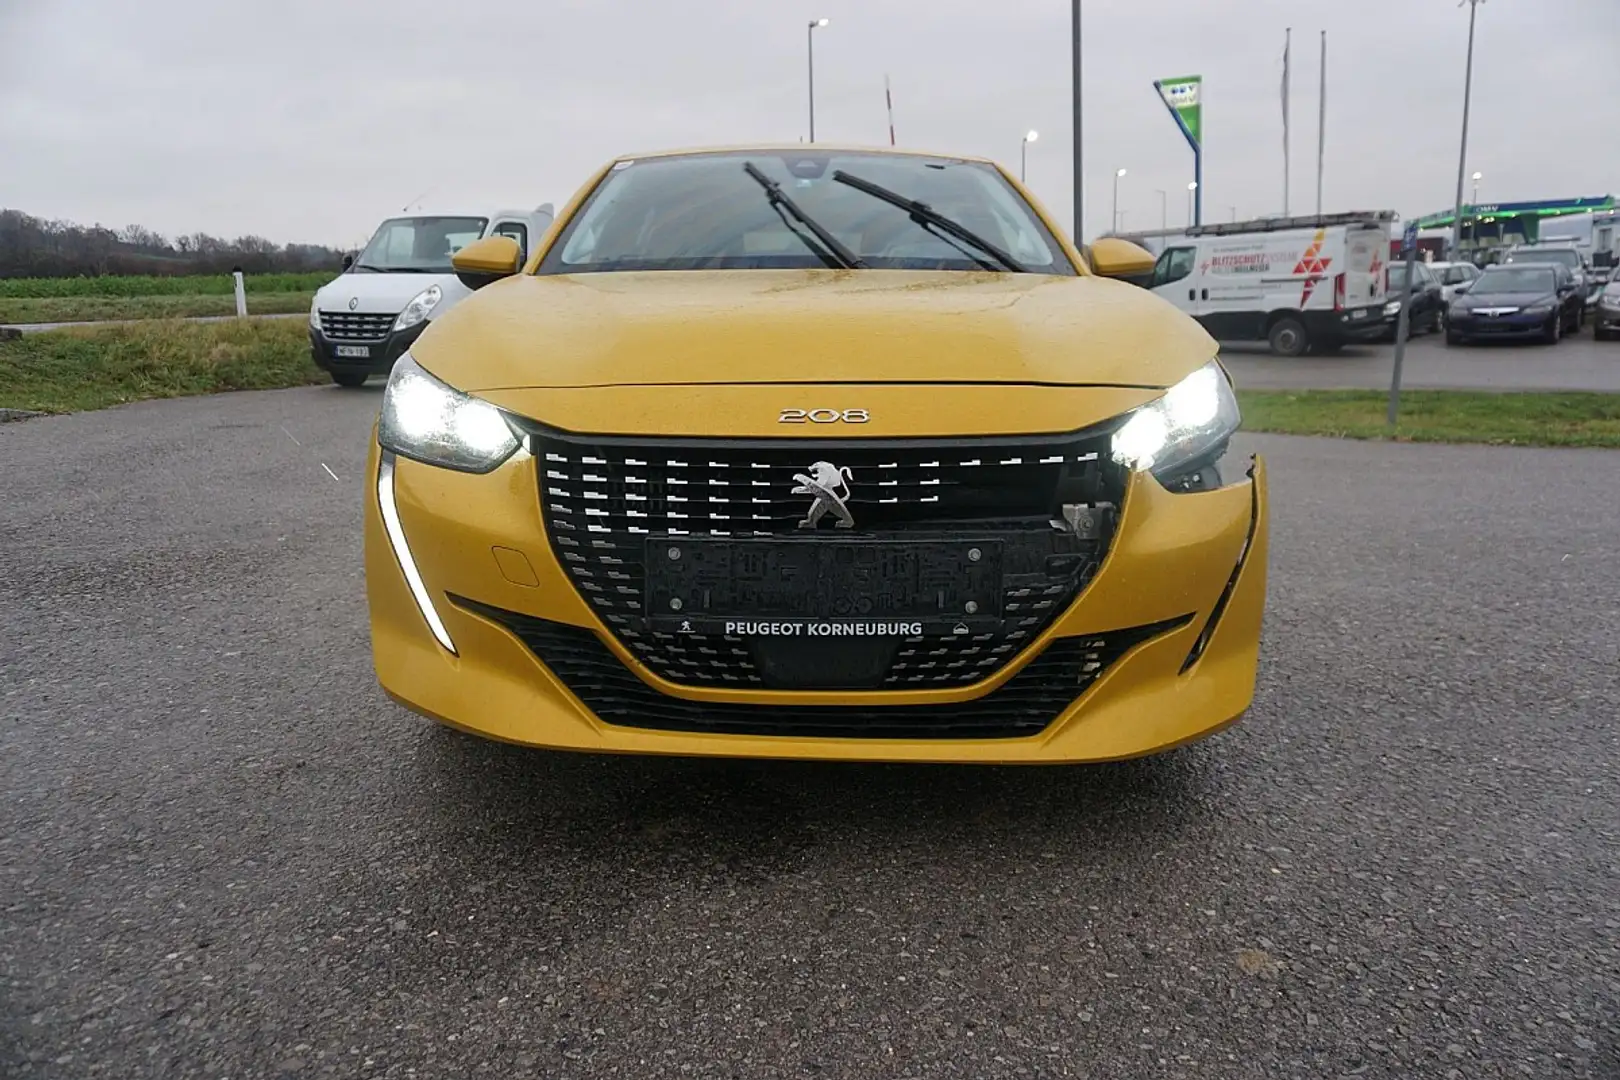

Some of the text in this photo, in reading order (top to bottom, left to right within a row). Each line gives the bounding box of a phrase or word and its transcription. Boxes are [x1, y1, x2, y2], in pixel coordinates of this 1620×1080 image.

[778, 408, 870, 423] 208
[725, 622, 922, 636] PEUGEOT KORNEUBURG
